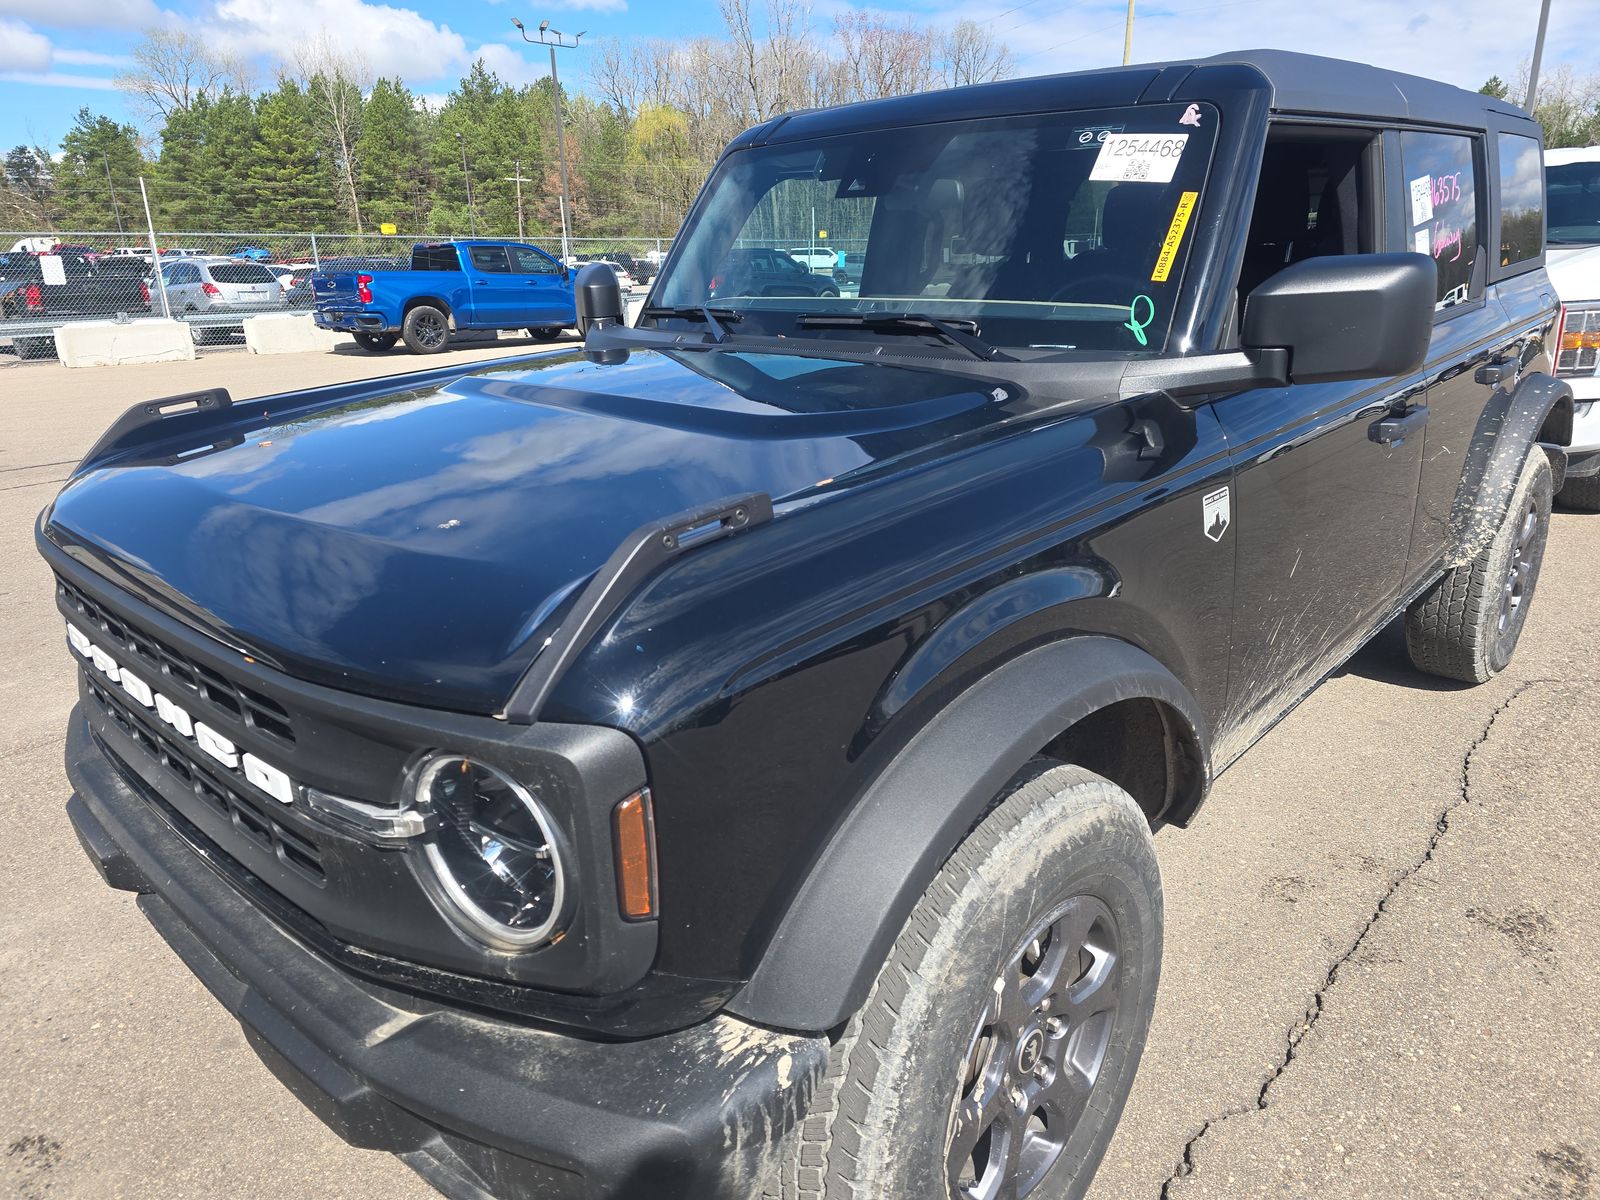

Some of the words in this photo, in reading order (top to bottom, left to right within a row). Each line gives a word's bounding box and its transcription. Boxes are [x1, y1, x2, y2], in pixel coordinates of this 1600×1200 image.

[1106, 138, 1186, 158] 1254468
[1154, 202, 1189, 280] 16884-A52375-R
[66, 622, 294, 804] BRONCO
